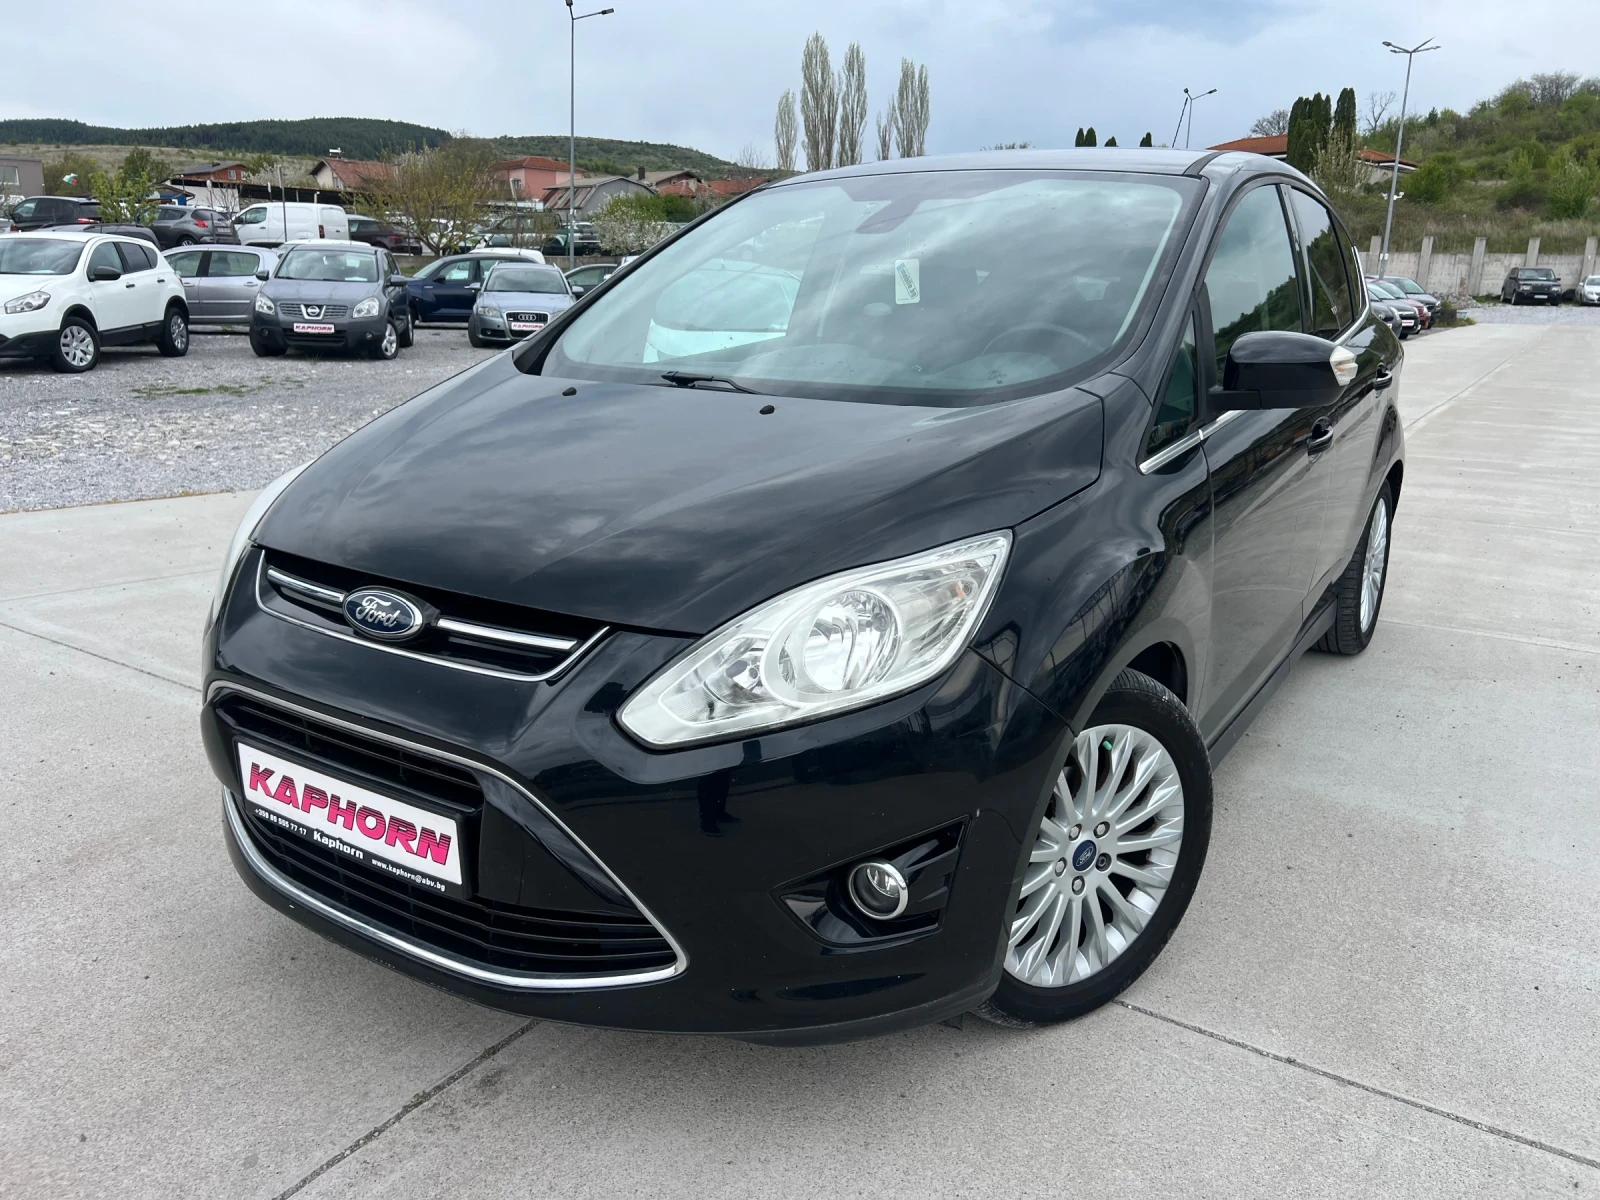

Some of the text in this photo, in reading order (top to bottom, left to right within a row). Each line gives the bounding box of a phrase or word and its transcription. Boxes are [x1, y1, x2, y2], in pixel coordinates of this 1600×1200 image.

[356, 596, 400, 628] Ford
[249, 761, 451, 865] KAPHORN
[290, 823, 298, 832] 77
[313, 830, 364, 860] Kaphorn
[371, 858, 446, 892] www.kaphorn@abv.bg
